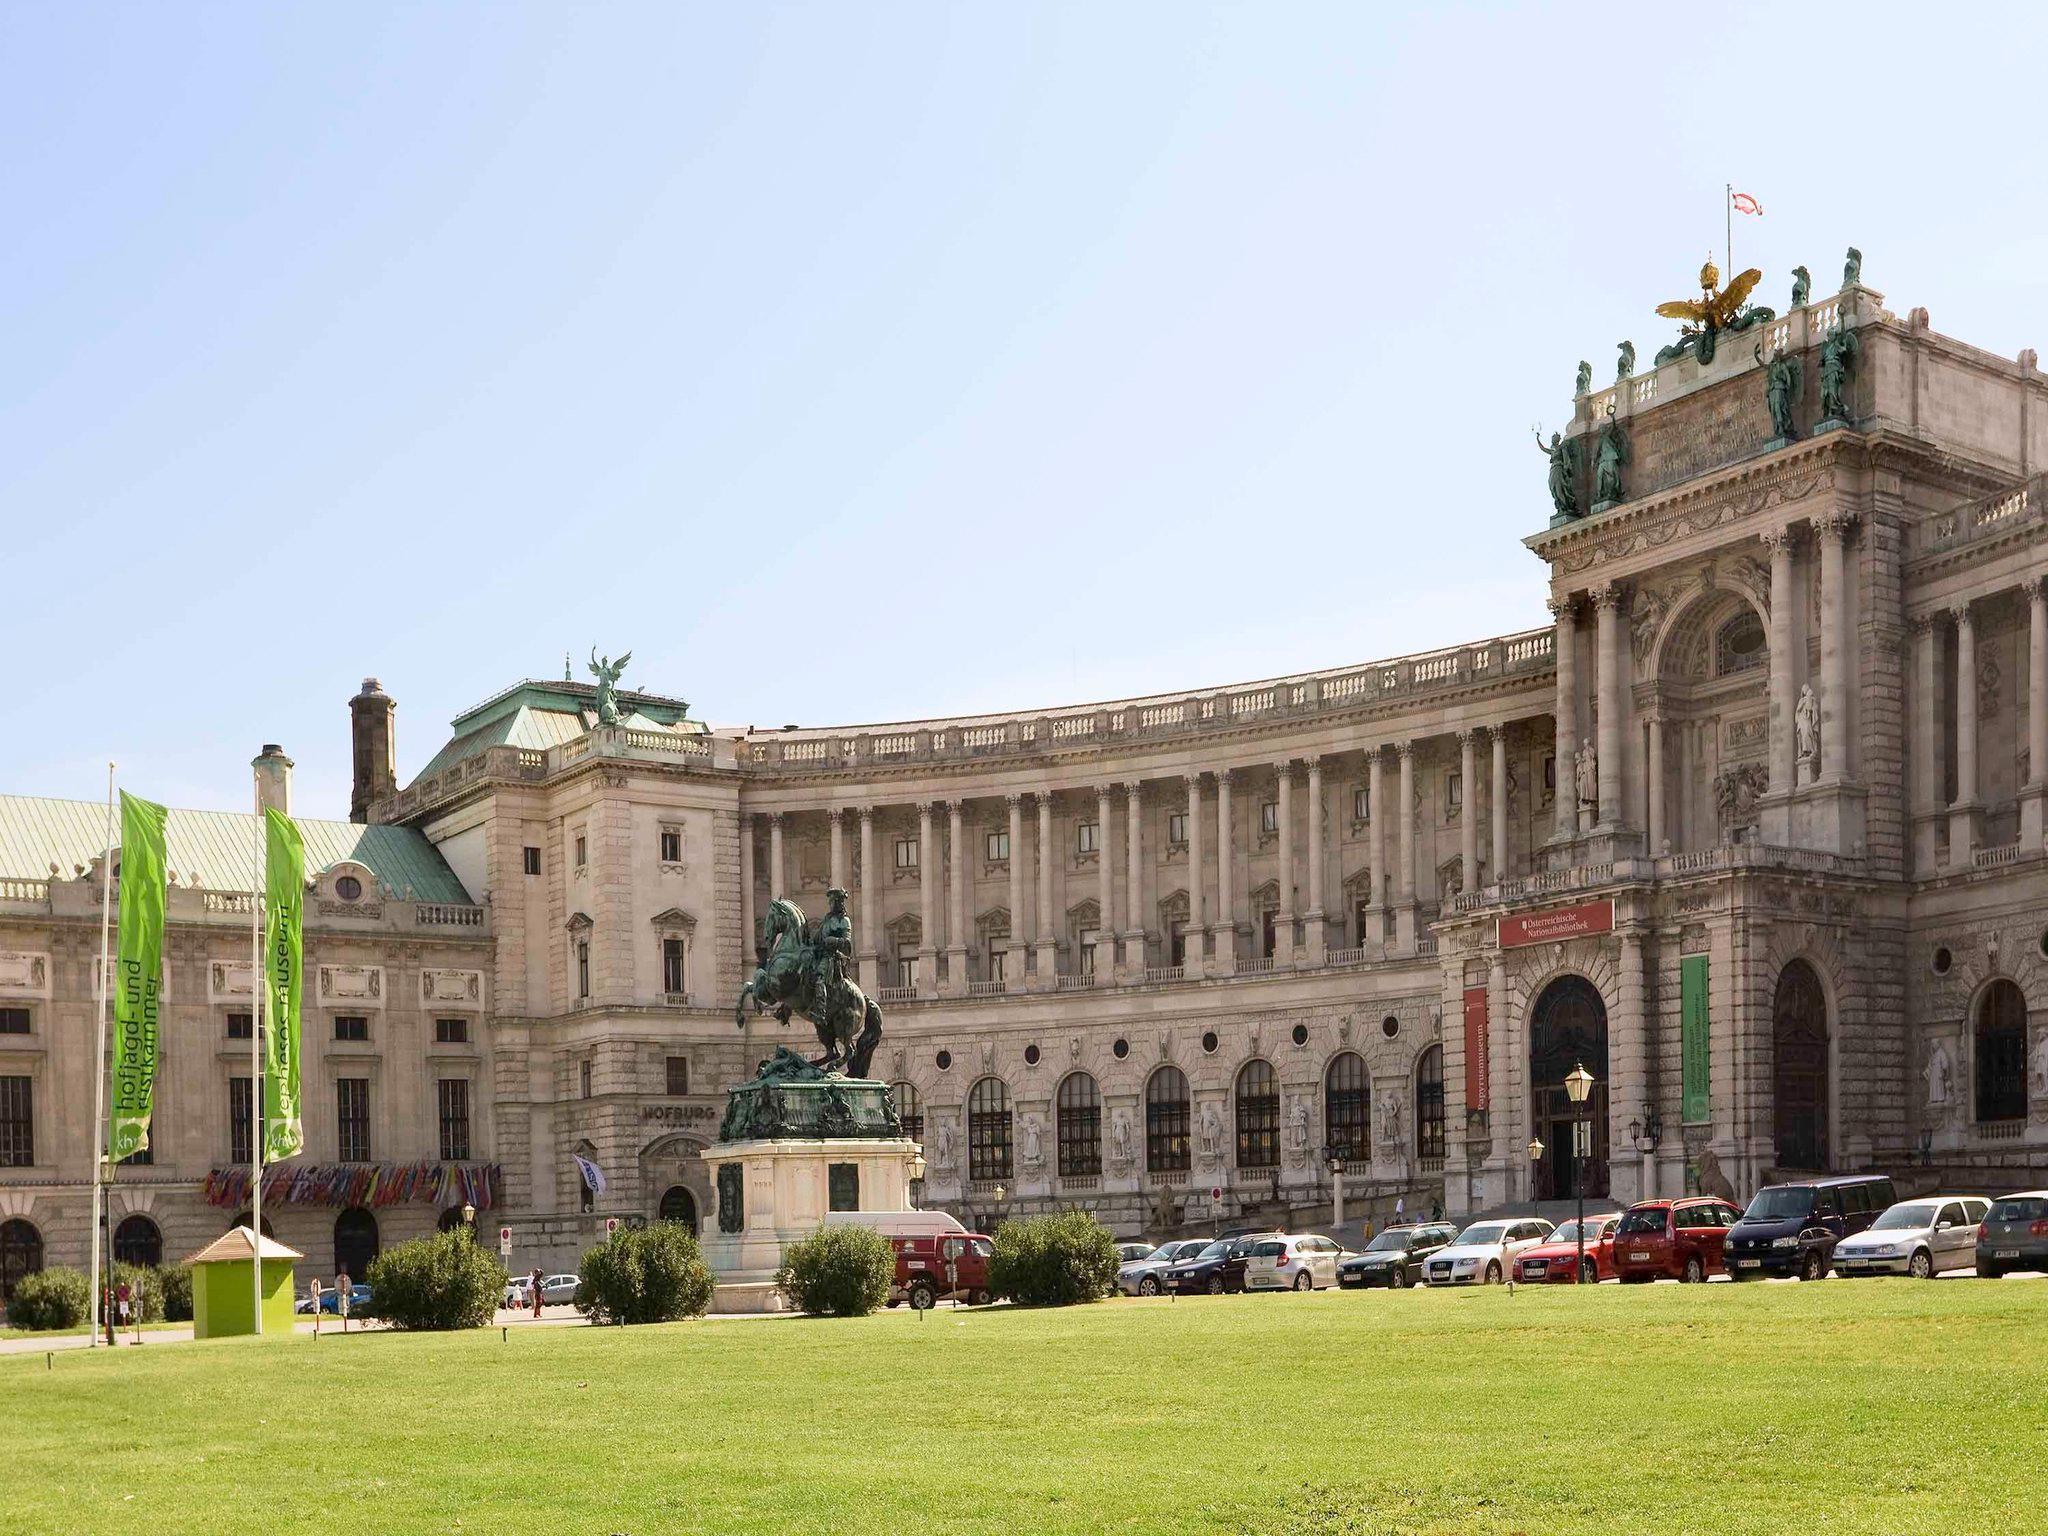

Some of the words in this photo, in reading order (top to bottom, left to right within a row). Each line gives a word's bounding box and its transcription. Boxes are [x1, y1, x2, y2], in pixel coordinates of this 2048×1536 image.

[1528, 913, 1577, 928] Österreichische
[1528, 920, 1588, 938] Nationalbibliothek
[123, 960, 141, 1004] und
[278, 906, 289, 1006] museum
[117, 1012, 142, 1110] hofjagd-
[276, 1018, 290, 1110] ephesos
[1478, 1024, 1486, 1110] Papyrusmuseum
[642, 1107, 715, 1119] HOFBURG
